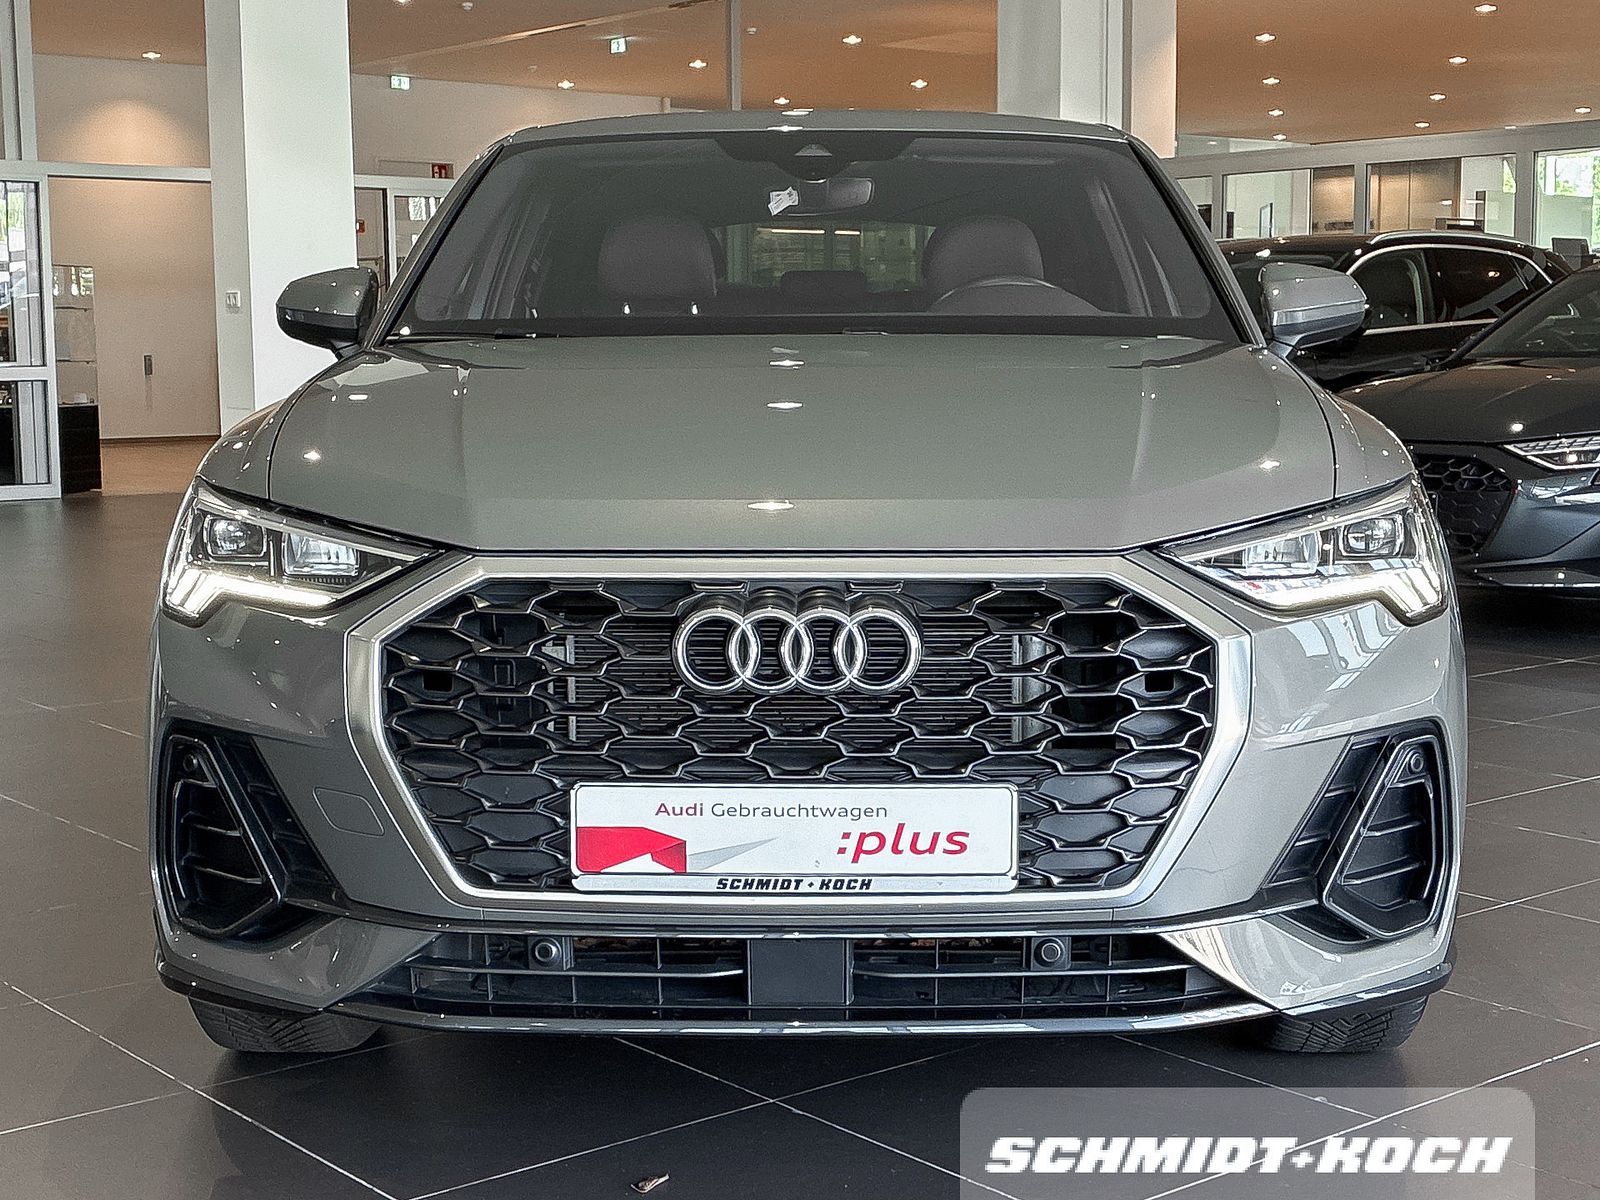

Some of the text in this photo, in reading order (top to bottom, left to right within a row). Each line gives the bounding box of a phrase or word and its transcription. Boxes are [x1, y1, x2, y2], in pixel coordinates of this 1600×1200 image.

[655, 803, 888, 822] Audi Gebrauchtwagen
[837, 822, 970, 863] :plus
[716, 878, 803, 891] SCHMIDT
[819, 878, 873, 891] KOCH
